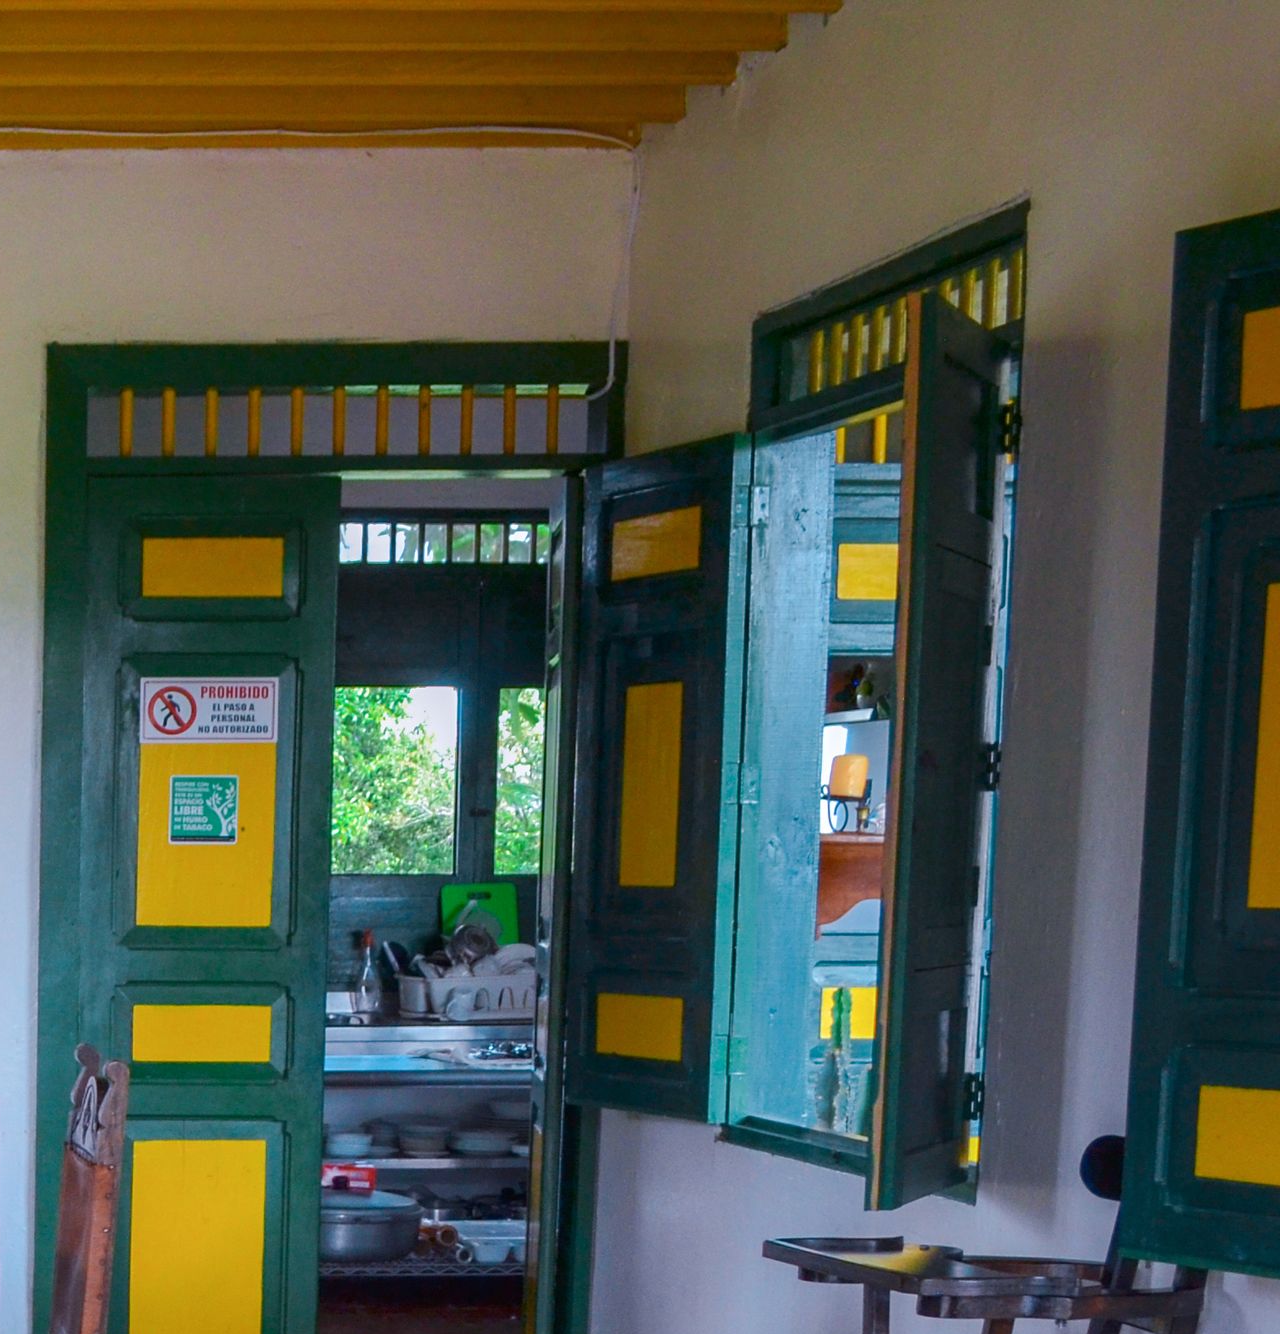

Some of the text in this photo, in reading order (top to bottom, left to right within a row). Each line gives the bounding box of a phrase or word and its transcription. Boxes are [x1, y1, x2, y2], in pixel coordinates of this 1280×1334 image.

[200, 686, 269, 699] PROHIBIDO
[212, 703, 255, 711] EL PASO A
[211, 714, 256, 722] PERSONAL
[212, 725, 269, 733] AUTORIZADO
[174, 805, 204, 815] LIBRE
[182, 823, 213, 831] TABACO
